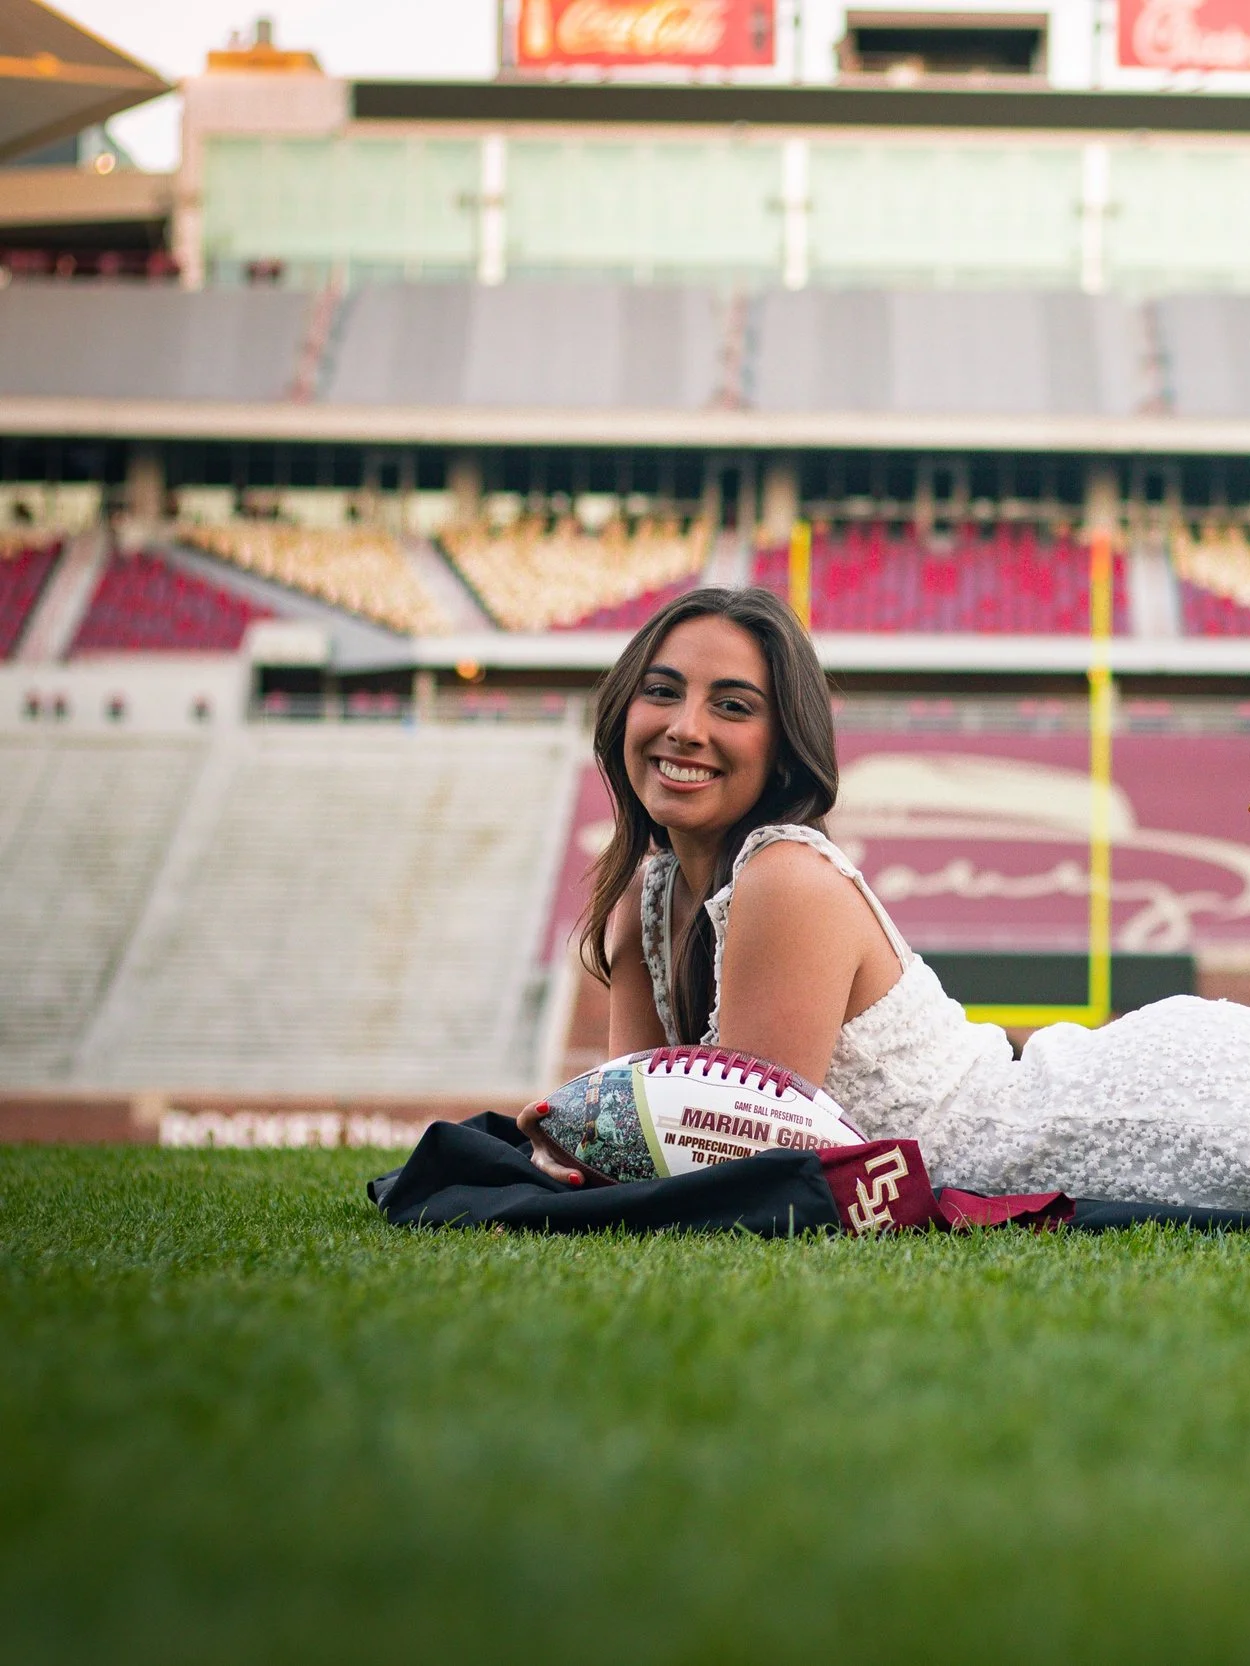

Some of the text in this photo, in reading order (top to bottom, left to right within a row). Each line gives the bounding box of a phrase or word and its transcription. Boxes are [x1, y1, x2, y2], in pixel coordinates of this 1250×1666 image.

[680, 1106, 772, 1144] MARIAN
[734, 1100, 813, 1128] GAME BALL PRESENTED TO
[664, 1132, 677, 1145] IN
[677, 1135, 752, 1158] APPRECIATION
[691, 1151, 705, 1164] TO
